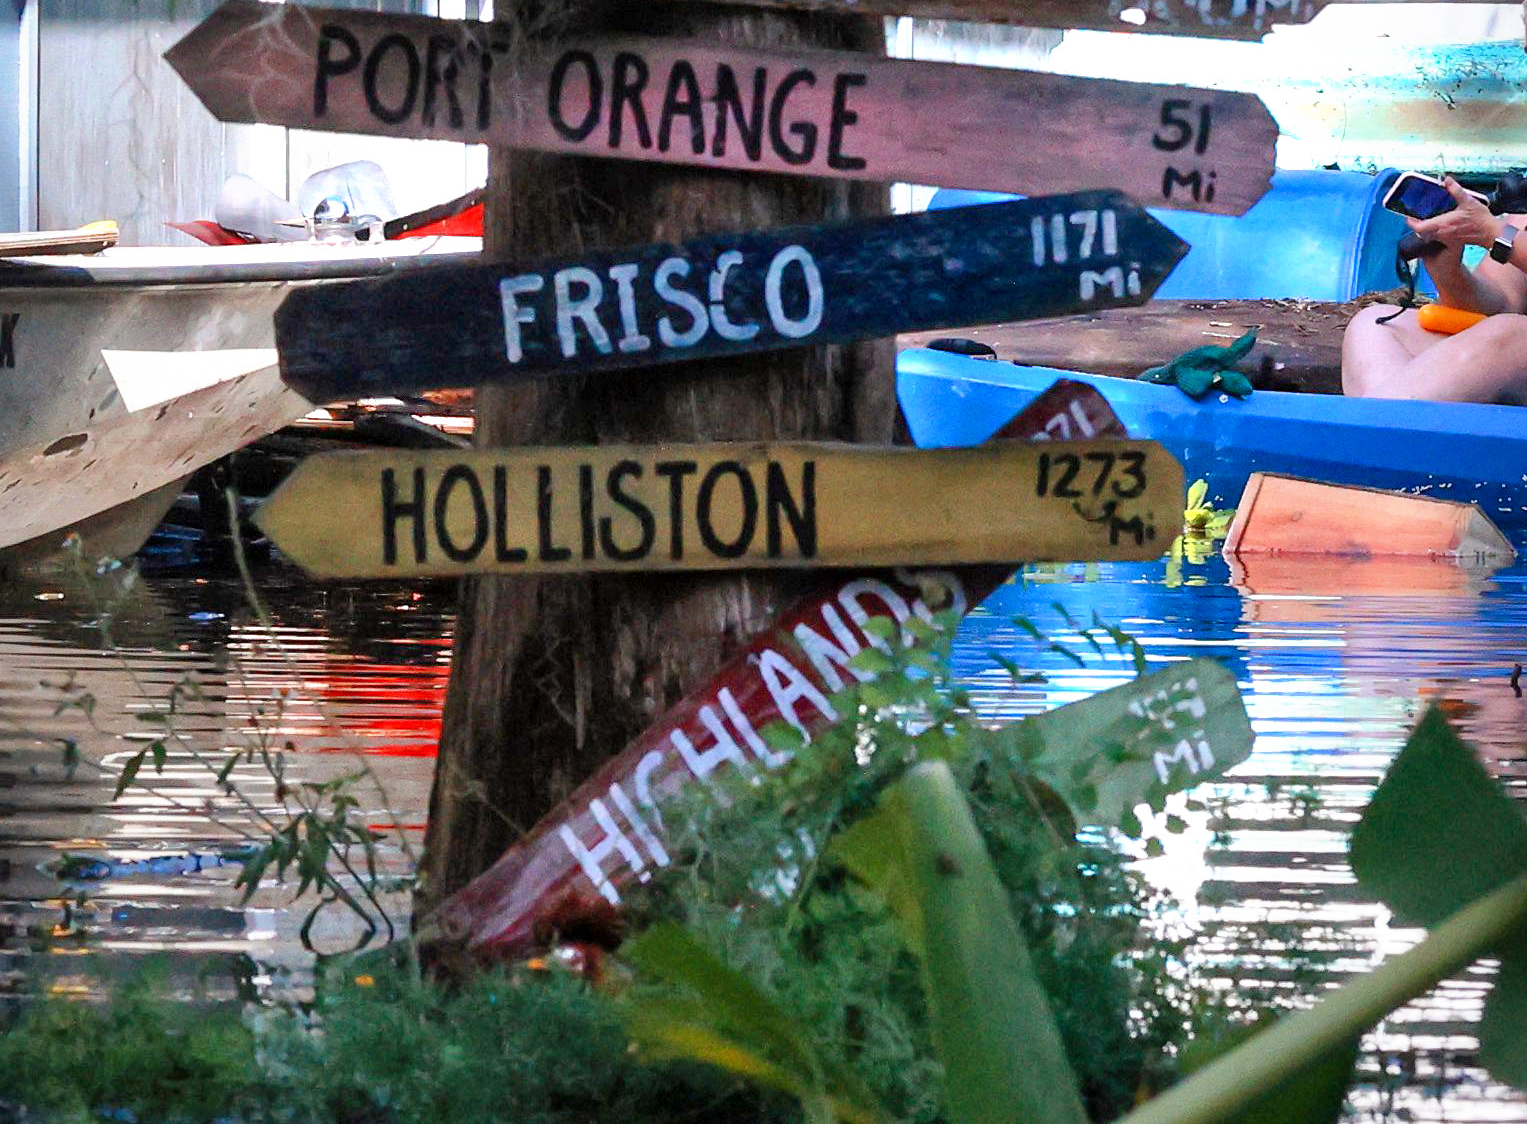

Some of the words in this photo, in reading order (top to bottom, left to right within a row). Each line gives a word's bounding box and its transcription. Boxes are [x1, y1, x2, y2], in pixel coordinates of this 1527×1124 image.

[313, 24, 509, 132] PORT
[548, 49, 867, 170] ORANGE
[1152, 98, 1212, 155] 51
[1162, 166, 1217, 204] Mi
[1031, 208, 1118, 267] 1171
[500, 245, 824, 363] FRISCO
[1079, 261, 1142, 301] Mi
[1036, 450, 1147, 498] 1273
[380, 459, 818, 566] HOLLISTON
